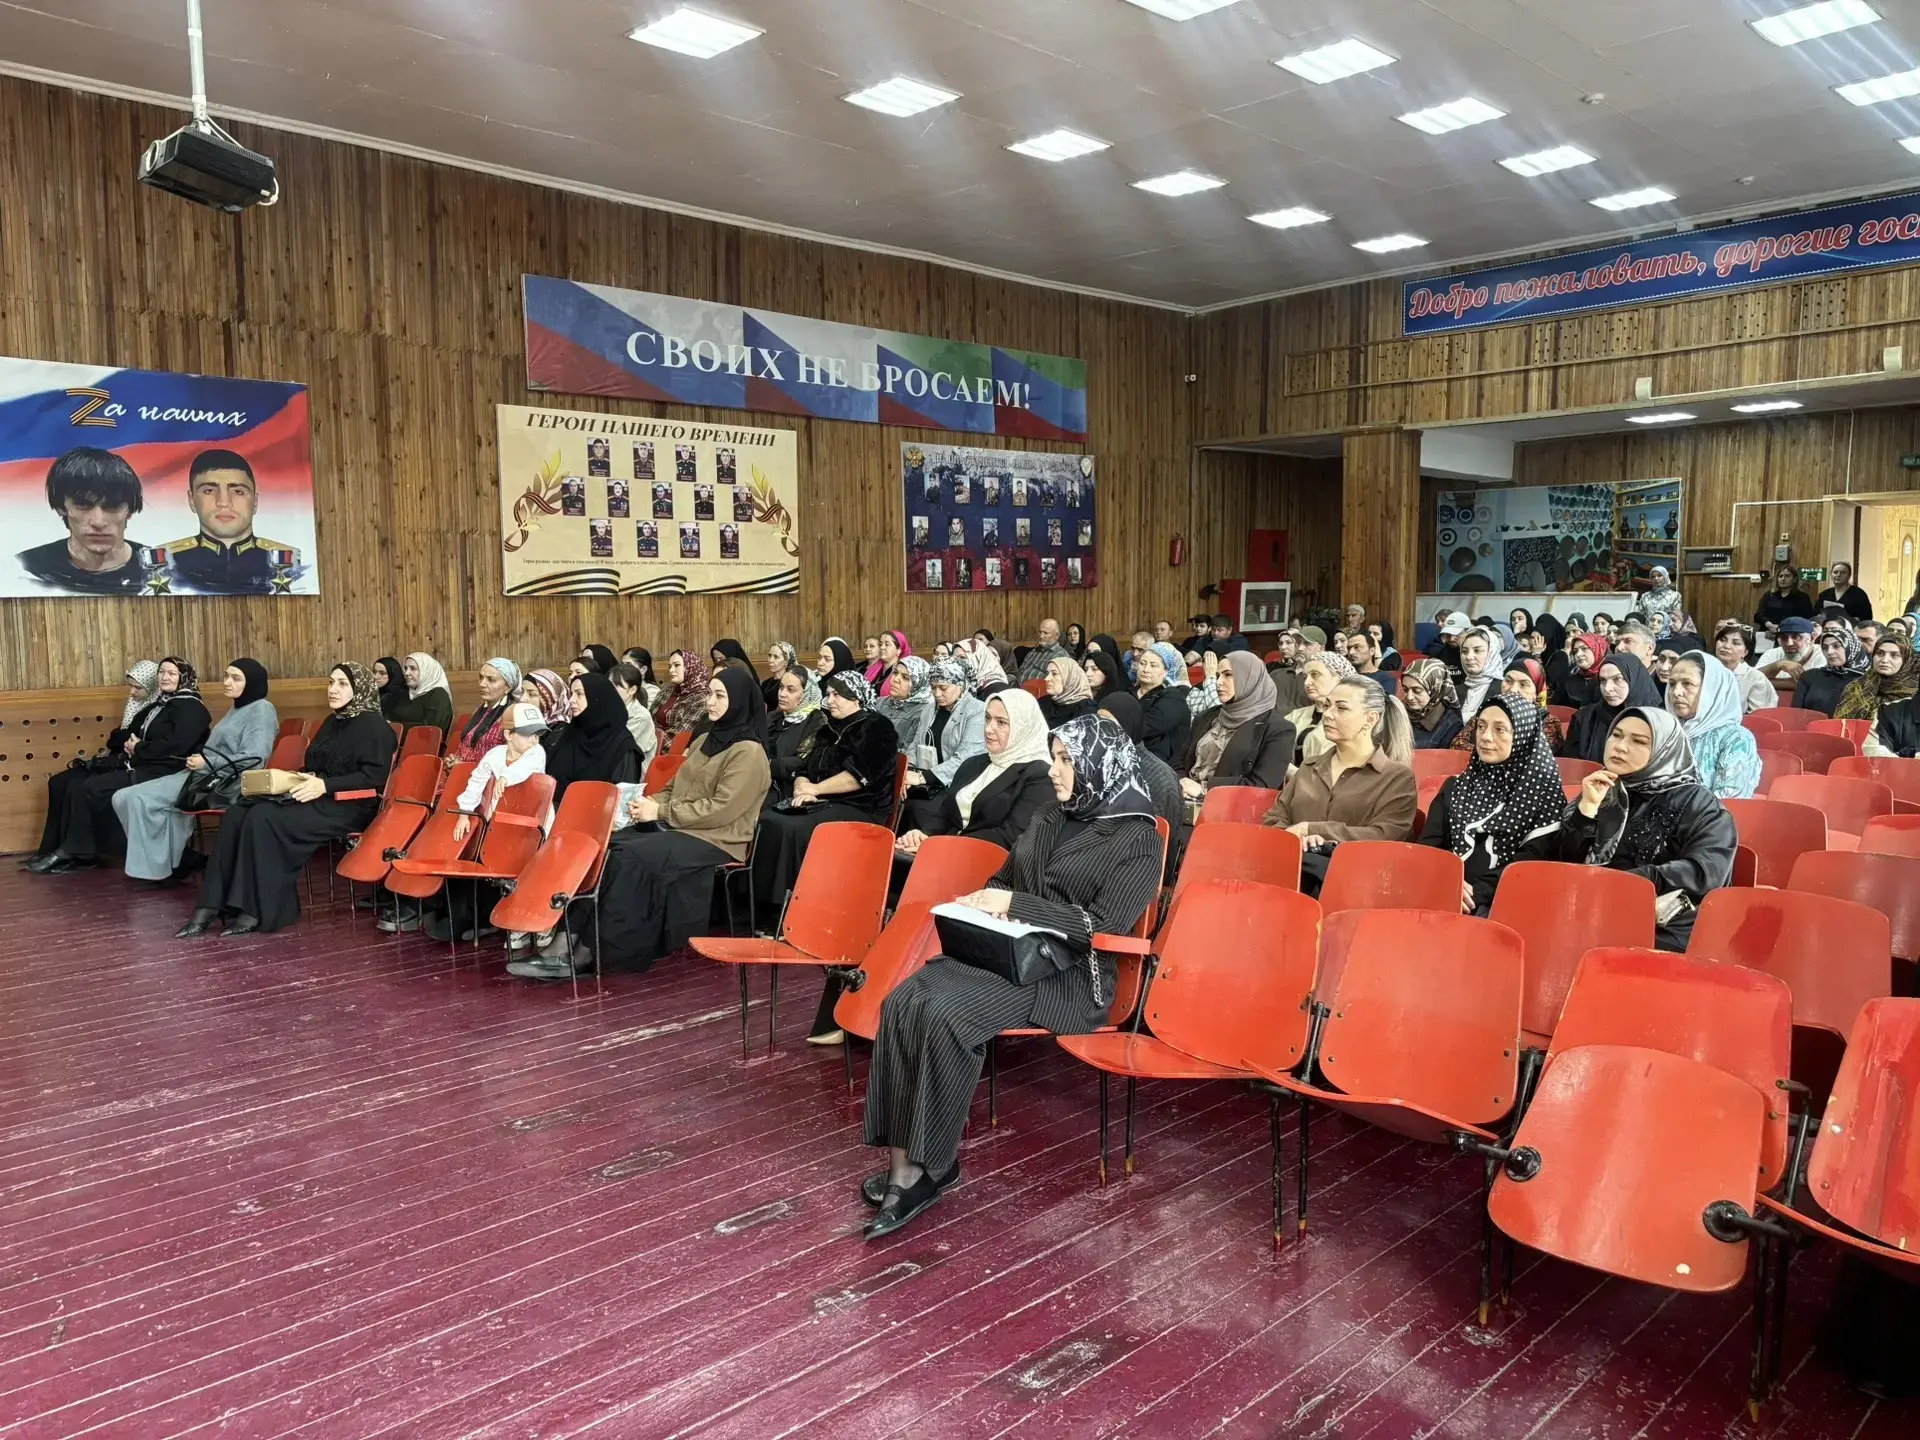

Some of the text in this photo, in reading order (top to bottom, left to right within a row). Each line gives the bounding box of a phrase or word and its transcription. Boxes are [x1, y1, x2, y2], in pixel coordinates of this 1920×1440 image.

[1408, 213, 1920, 319] Добро пожаловать, дорогие гос
[626, 330, 1030, 410] СВОИХ НЕ БРОСАЕМ!
[138, 405, 247, 427] наших
[526, 412, 777, 447] ГЕРОИ НАШЕГО ВРЕМЕНИ
